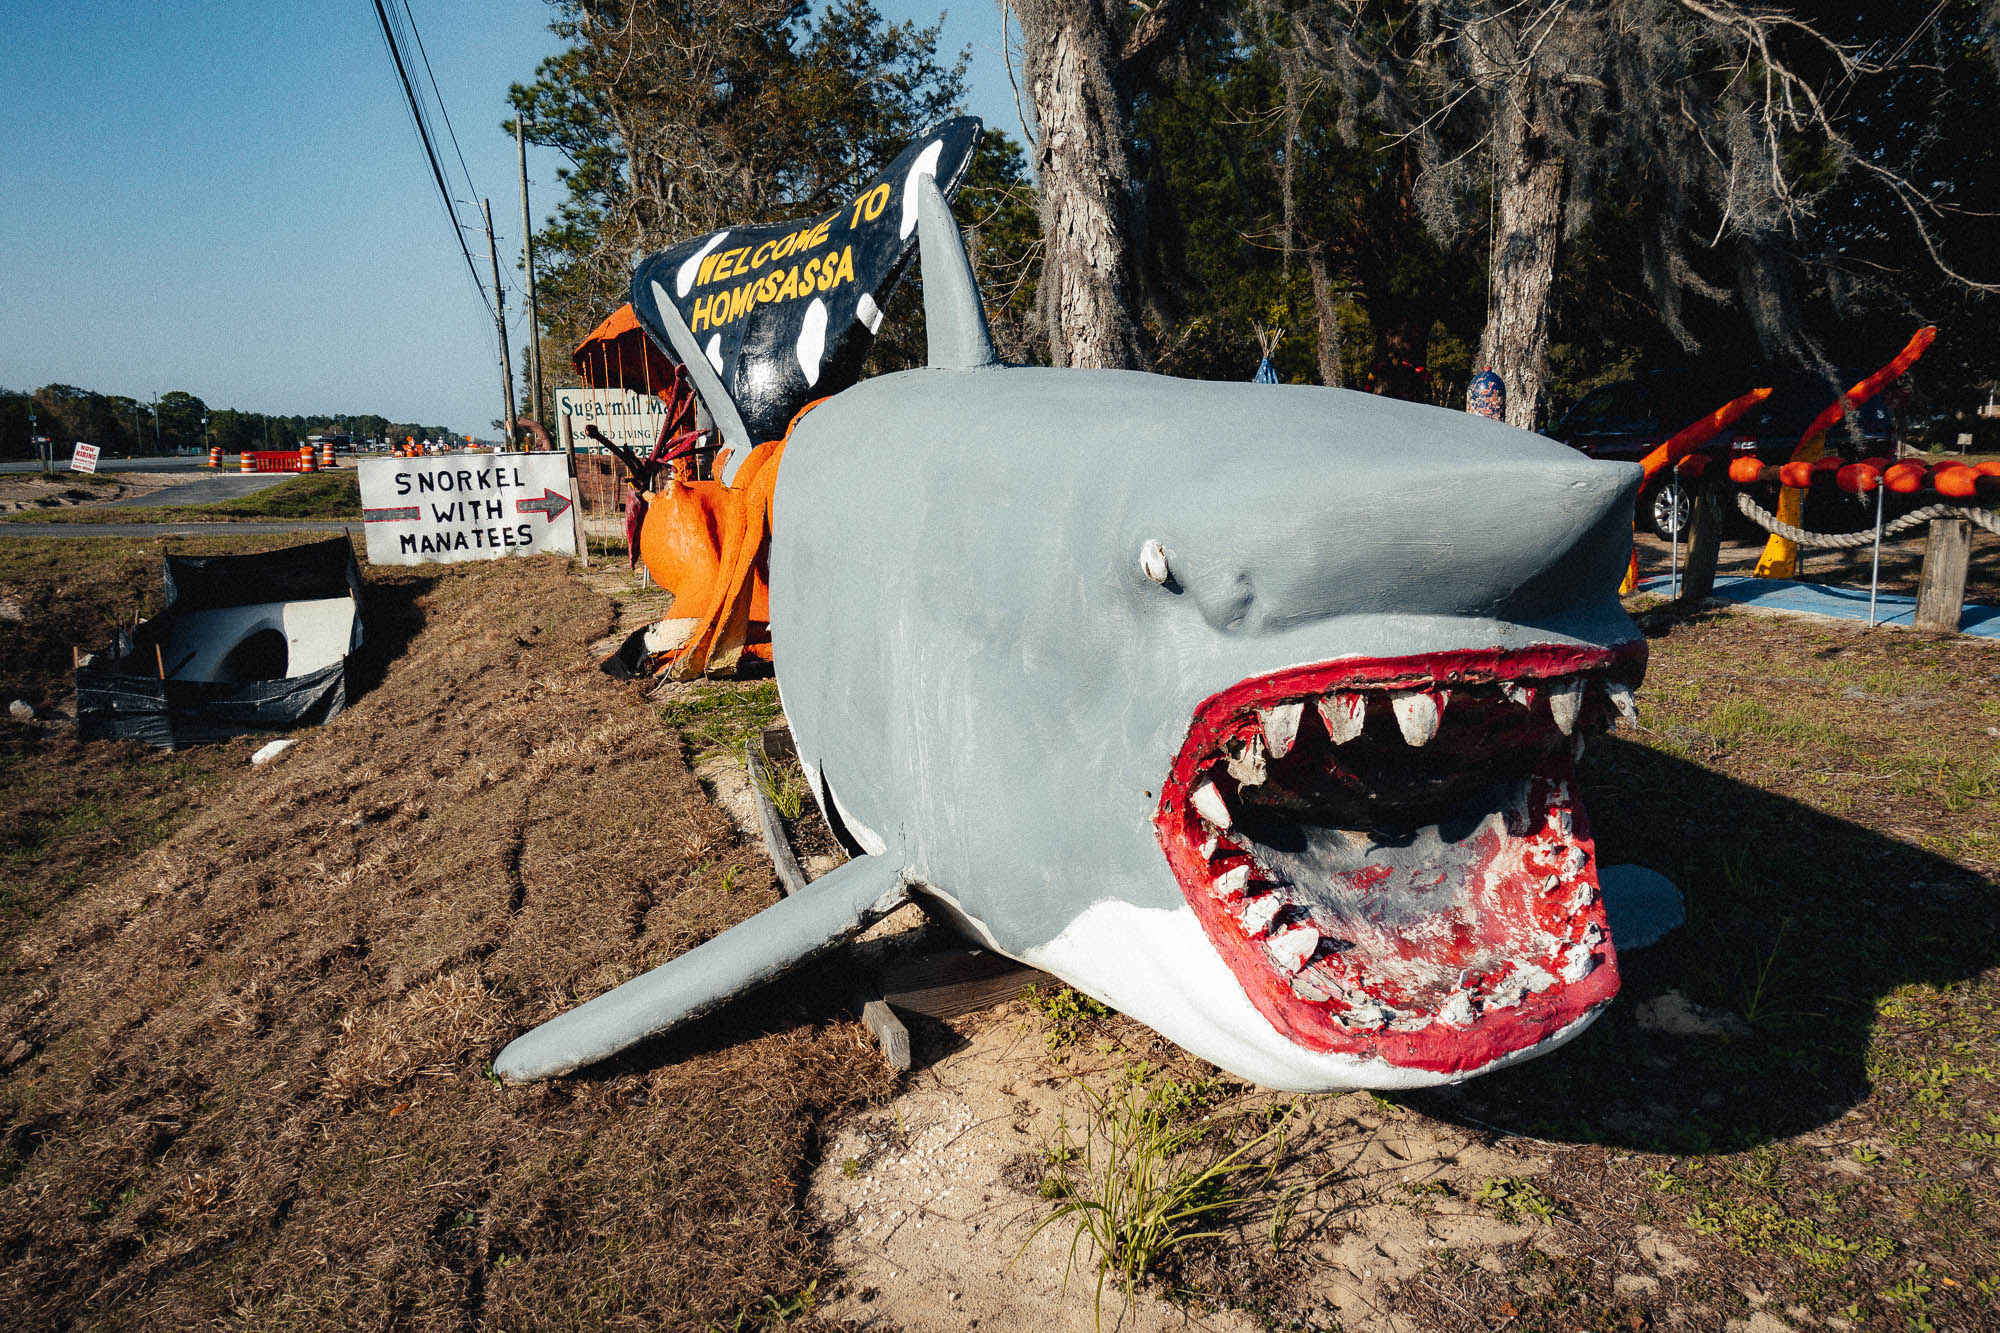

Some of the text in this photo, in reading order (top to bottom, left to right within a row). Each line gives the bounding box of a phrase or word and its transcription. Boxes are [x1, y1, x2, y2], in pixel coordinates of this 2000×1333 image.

[696, 183, 890, 286] WELCOME TO
[691, 245, 855, 333] HOMOSASSA
[562, 396, 641, 420] Sugarmill
[395, 467, 526, 495] SNORKEL
[431, 499, 504, 523] WITH
[400, 524, 534, 555] MANATEES
